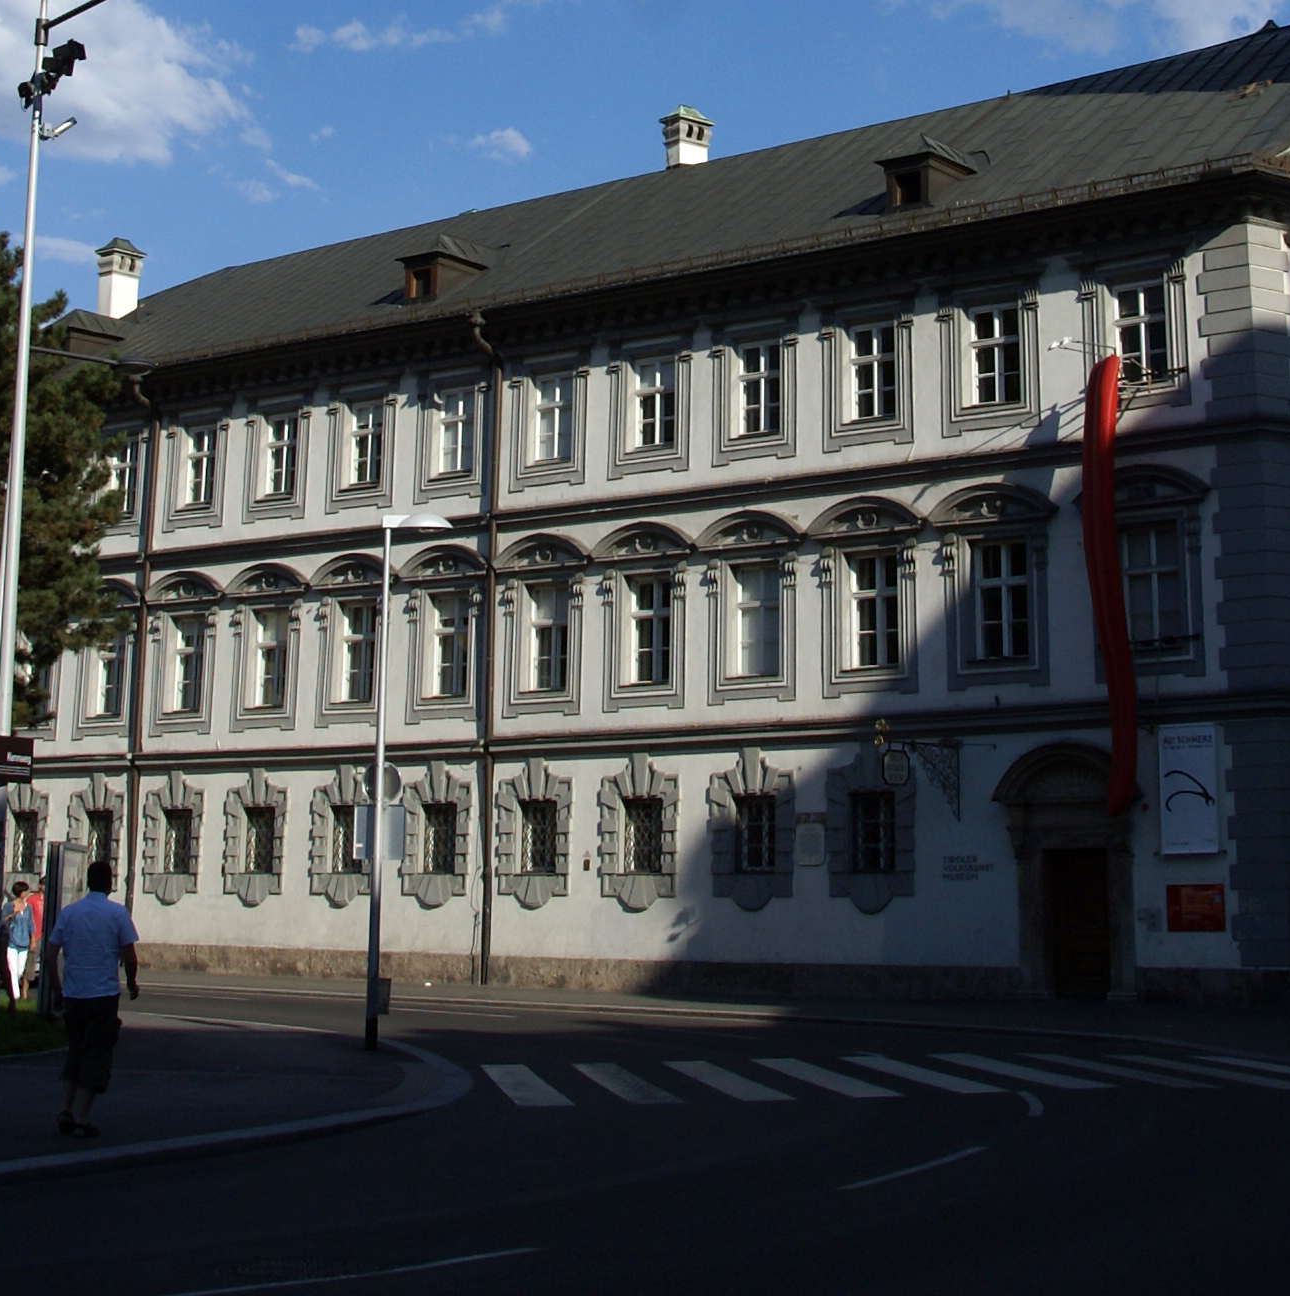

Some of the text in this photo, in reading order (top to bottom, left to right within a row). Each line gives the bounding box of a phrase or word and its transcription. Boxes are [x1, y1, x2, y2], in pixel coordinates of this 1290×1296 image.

[942, 855, 979, 864] TIROLER
[942, 864, 995, 873] VOLKSKUNST
[942, 873, 979, 881] MUSEUM
